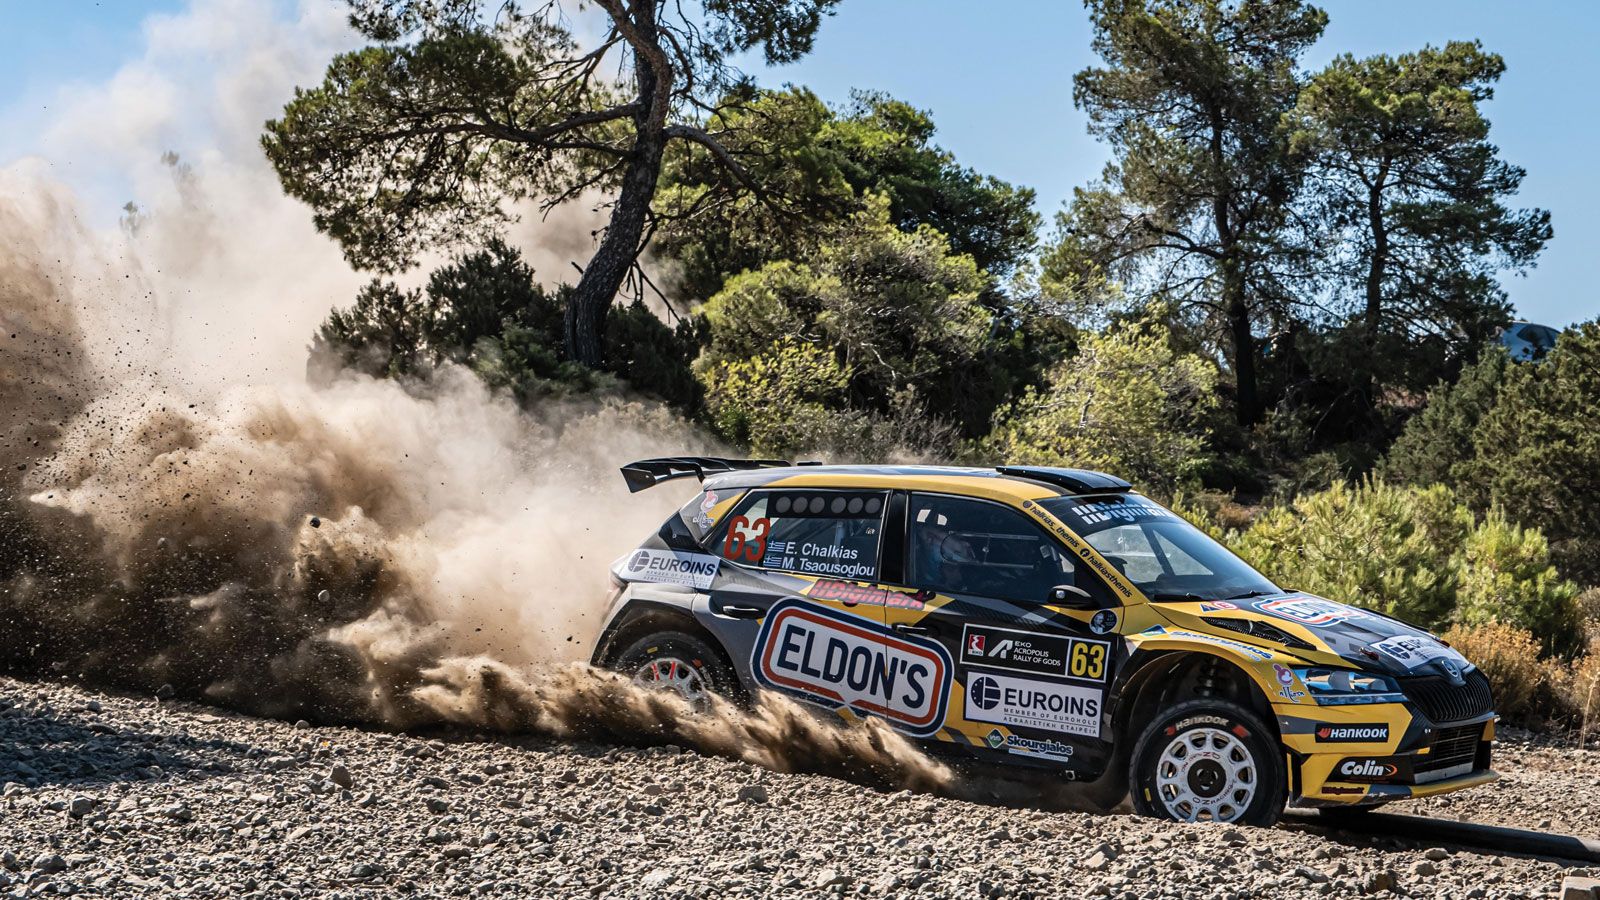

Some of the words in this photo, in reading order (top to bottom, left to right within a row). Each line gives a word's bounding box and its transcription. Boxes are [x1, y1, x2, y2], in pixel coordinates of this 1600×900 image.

[723, 515, 771, 561] 63
[785, 541, 798, 555] E.
[801, 542, 858, 560] Chalkias
[649, 557, 716, 576] EUROINS
[781, 557, 796, 570] M.
[800, 558, 875, 577] Tsaousoglou
[1087, 555, 1133, 598] halkiasthemis
[1013, 647, 1049, 657] ACROPOLIS
[1014, 640, 1032, 648] EKO
[776, 623, 929, 709] ELDON'S
[1013, 654, 1032, 663] RALLY
[1042, 658, 1061, 667] GODS
[1071, 642, 1105, 679] 63
[1004, 687, 1098, 718] EUROINS
[1003, 707, 1037, 717] MEMBER
[1054, 714, 1097, 726] EUROHOLD
[1007, 735, 1073, 755] Skourgialos
[1340, 760, 1384, 776] Colin
